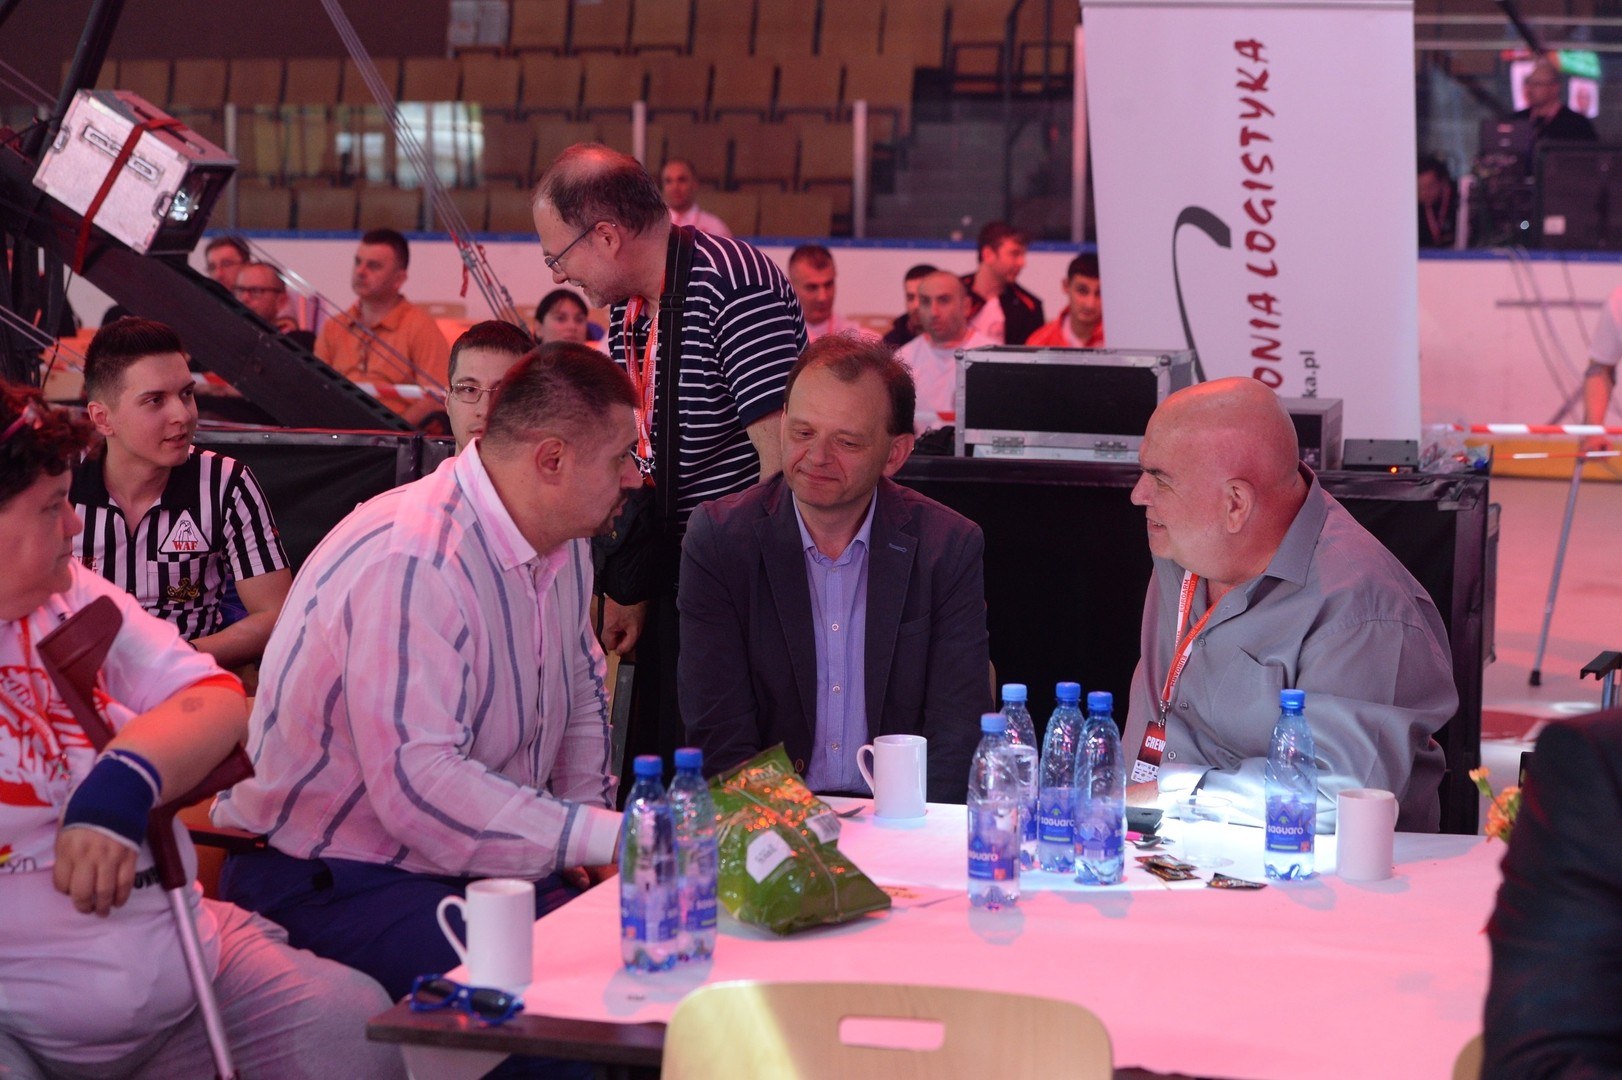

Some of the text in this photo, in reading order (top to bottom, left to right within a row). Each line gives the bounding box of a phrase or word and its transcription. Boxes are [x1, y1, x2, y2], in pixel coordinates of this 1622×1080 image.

[1234, 38, 1278, 278] LOGISTYKA
[172, 540, 198, 551] WAF
[1179, 578, 1190, 613] EUROARM
[1170, 655, 1187, 687] EUROARM
[1145, 735, 1166, 752] CREW
